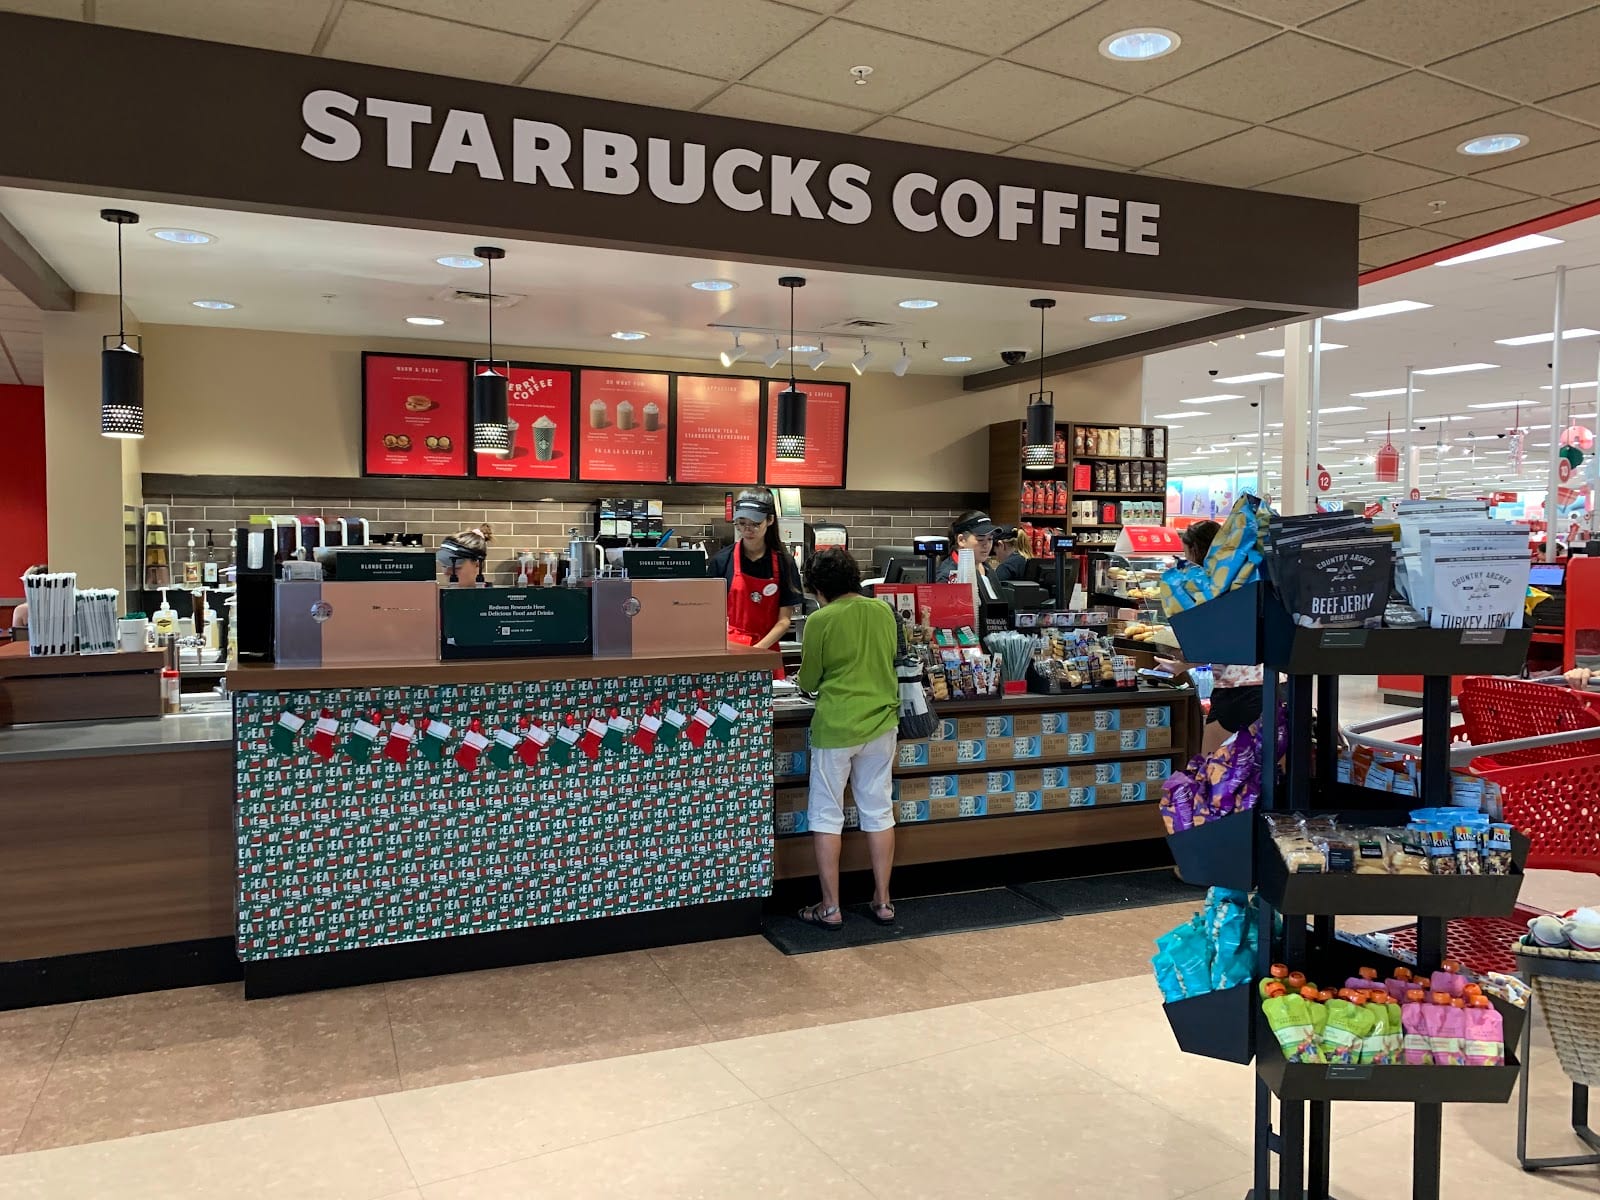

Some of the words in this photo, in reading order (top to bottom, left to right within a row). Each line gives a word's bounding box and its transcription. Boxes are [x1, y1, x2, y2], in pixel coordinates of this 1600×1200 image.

[301, 89, 872, 225] STARBUCKS
[892, 172, 1160, 256] COFFEE
[508, 375, 536, 392] ERRY
[513, 378, 553, 400] COFFEE
[1561, 466, 1568, 476] 10
[1320, 476, 1329, 486] 12
[1316, 554, 1348, 570] COUNTRY
[1350, 554, 1375, 566] ARCHER
[1452, 572, 1483, 588] COUNTRY
[1486, 572, 1512, 585] ARCHER
[1312, 596, 1339, 614] BEEF
[1340, 593, 1374, 613] JERKY
[1440, 614, 1482, 629] TURKEY
[1484, 612, 1514, 629] JERKY
